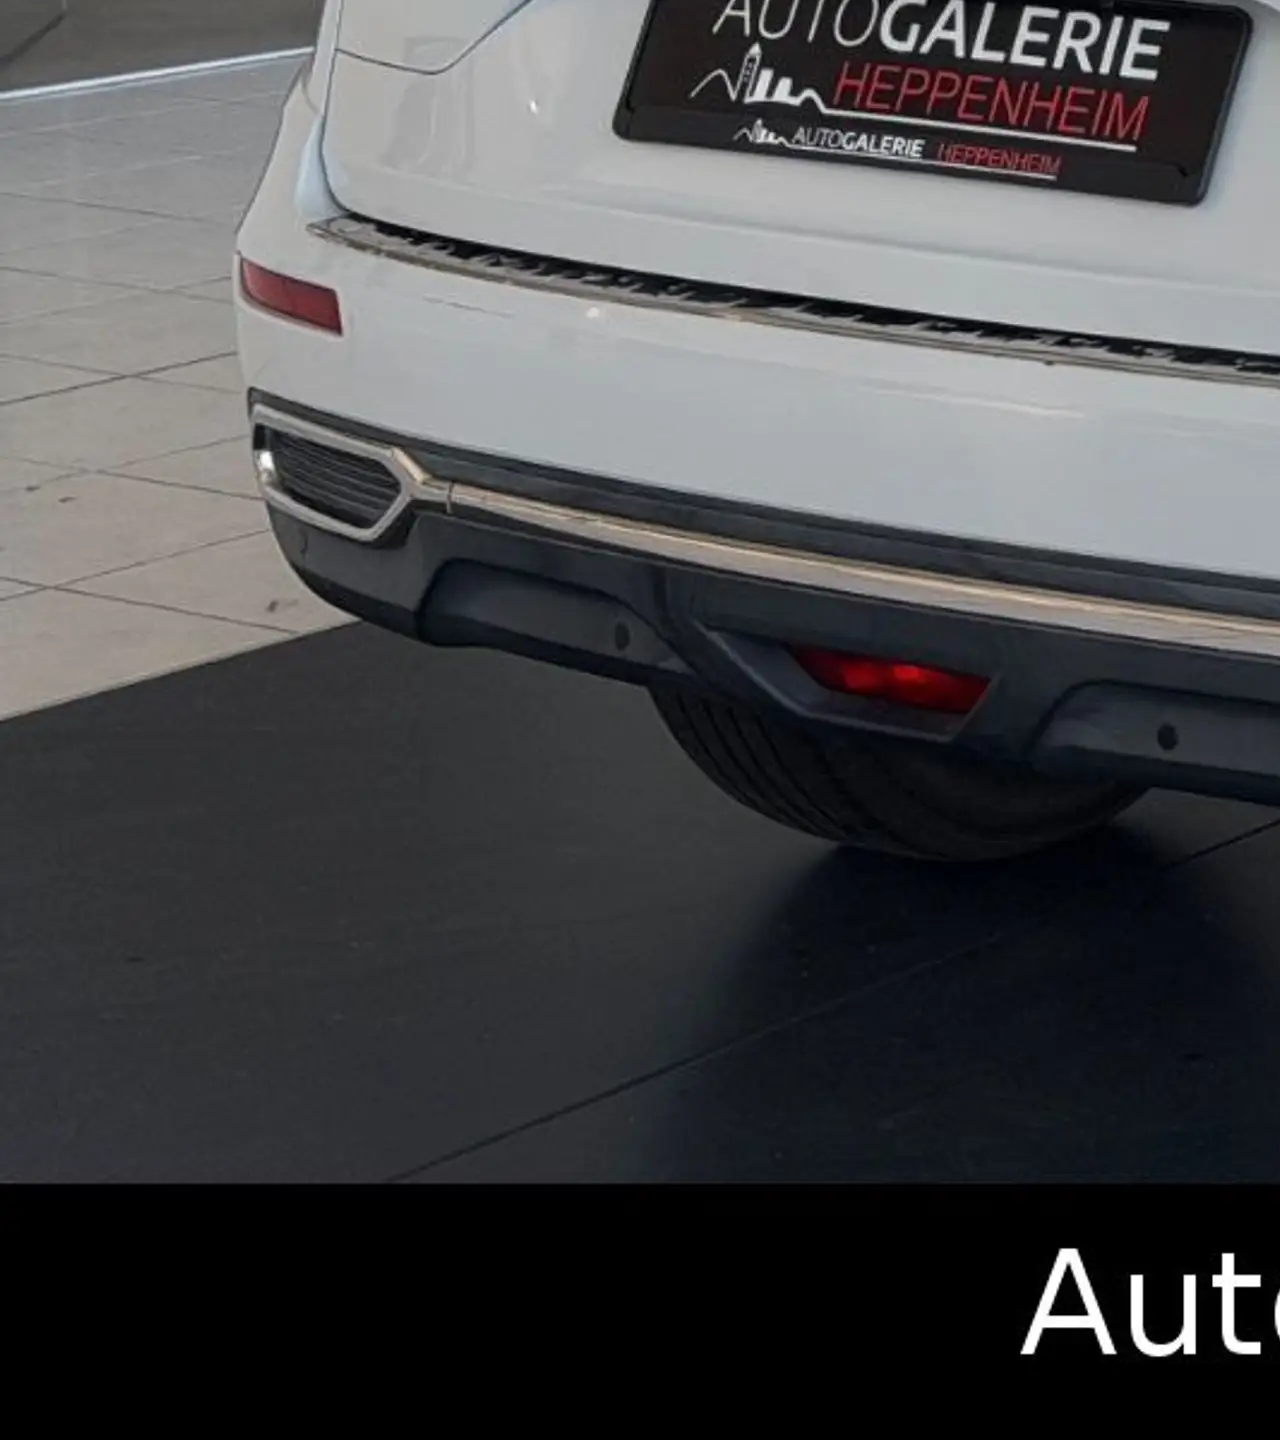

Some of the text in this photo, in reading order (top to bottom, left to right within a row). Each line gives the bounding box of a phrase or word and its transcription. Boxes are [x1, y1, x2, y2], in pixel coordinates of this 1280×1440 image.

[832, 60, 1150, 141] HEPPENHEIM
[793, 126, 1062, 176] AUTOGALERIE HEPPENHEIM
